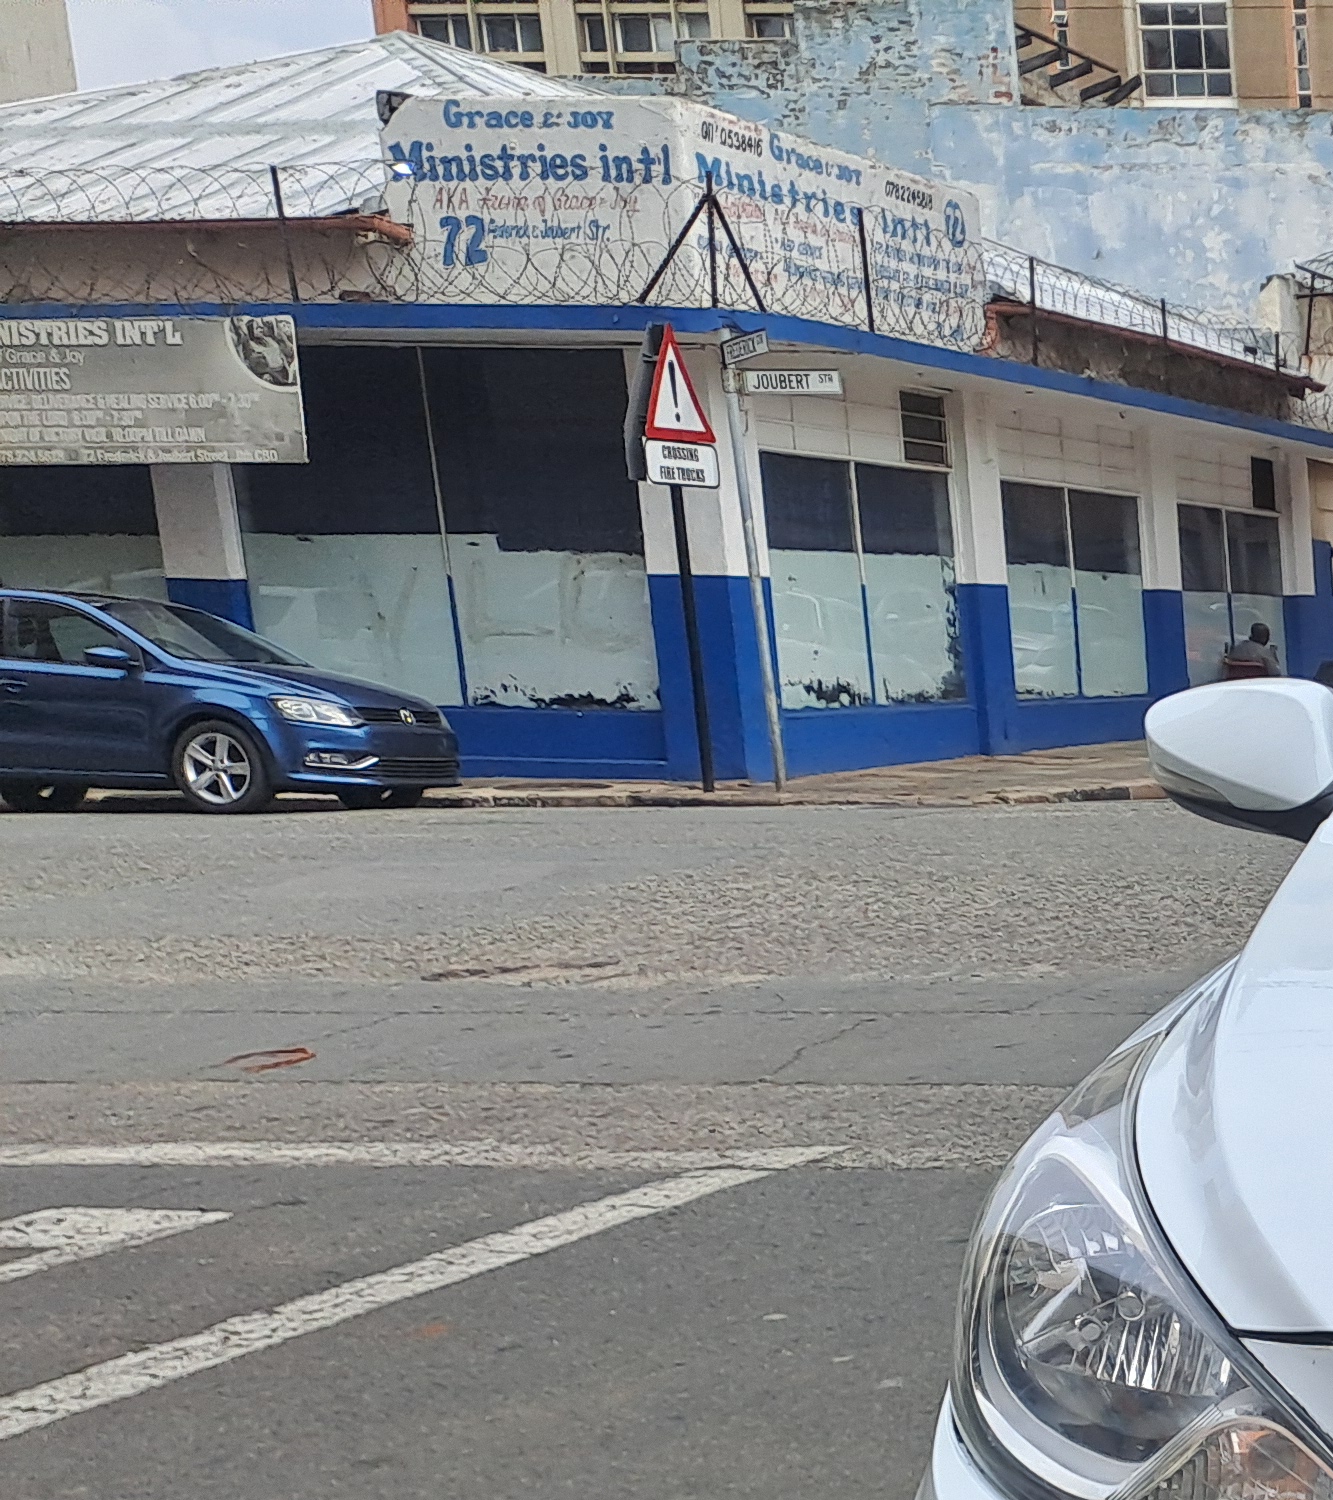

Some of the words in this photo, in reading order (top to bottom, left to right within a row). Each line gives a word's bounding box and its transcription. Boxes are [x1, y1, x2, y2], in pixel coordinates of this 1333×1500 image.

[443, 99, 534, 129] Grace
[388, 140, 588, 182] Ministries
[769, 132, 824, 176] Grace
[694, 151, 861, 227] Ministries
[438, 215, 489, 268] 72
[114, 320, 183, 346] INT'L
[5, 348, 47, 365] Grace
[62, 349, 86, 366] Joy
[753, 373, 810, 390] JOUBERT
[818, 373, 834, 384] STR
[662, 445, 699, 462] CROSSING
